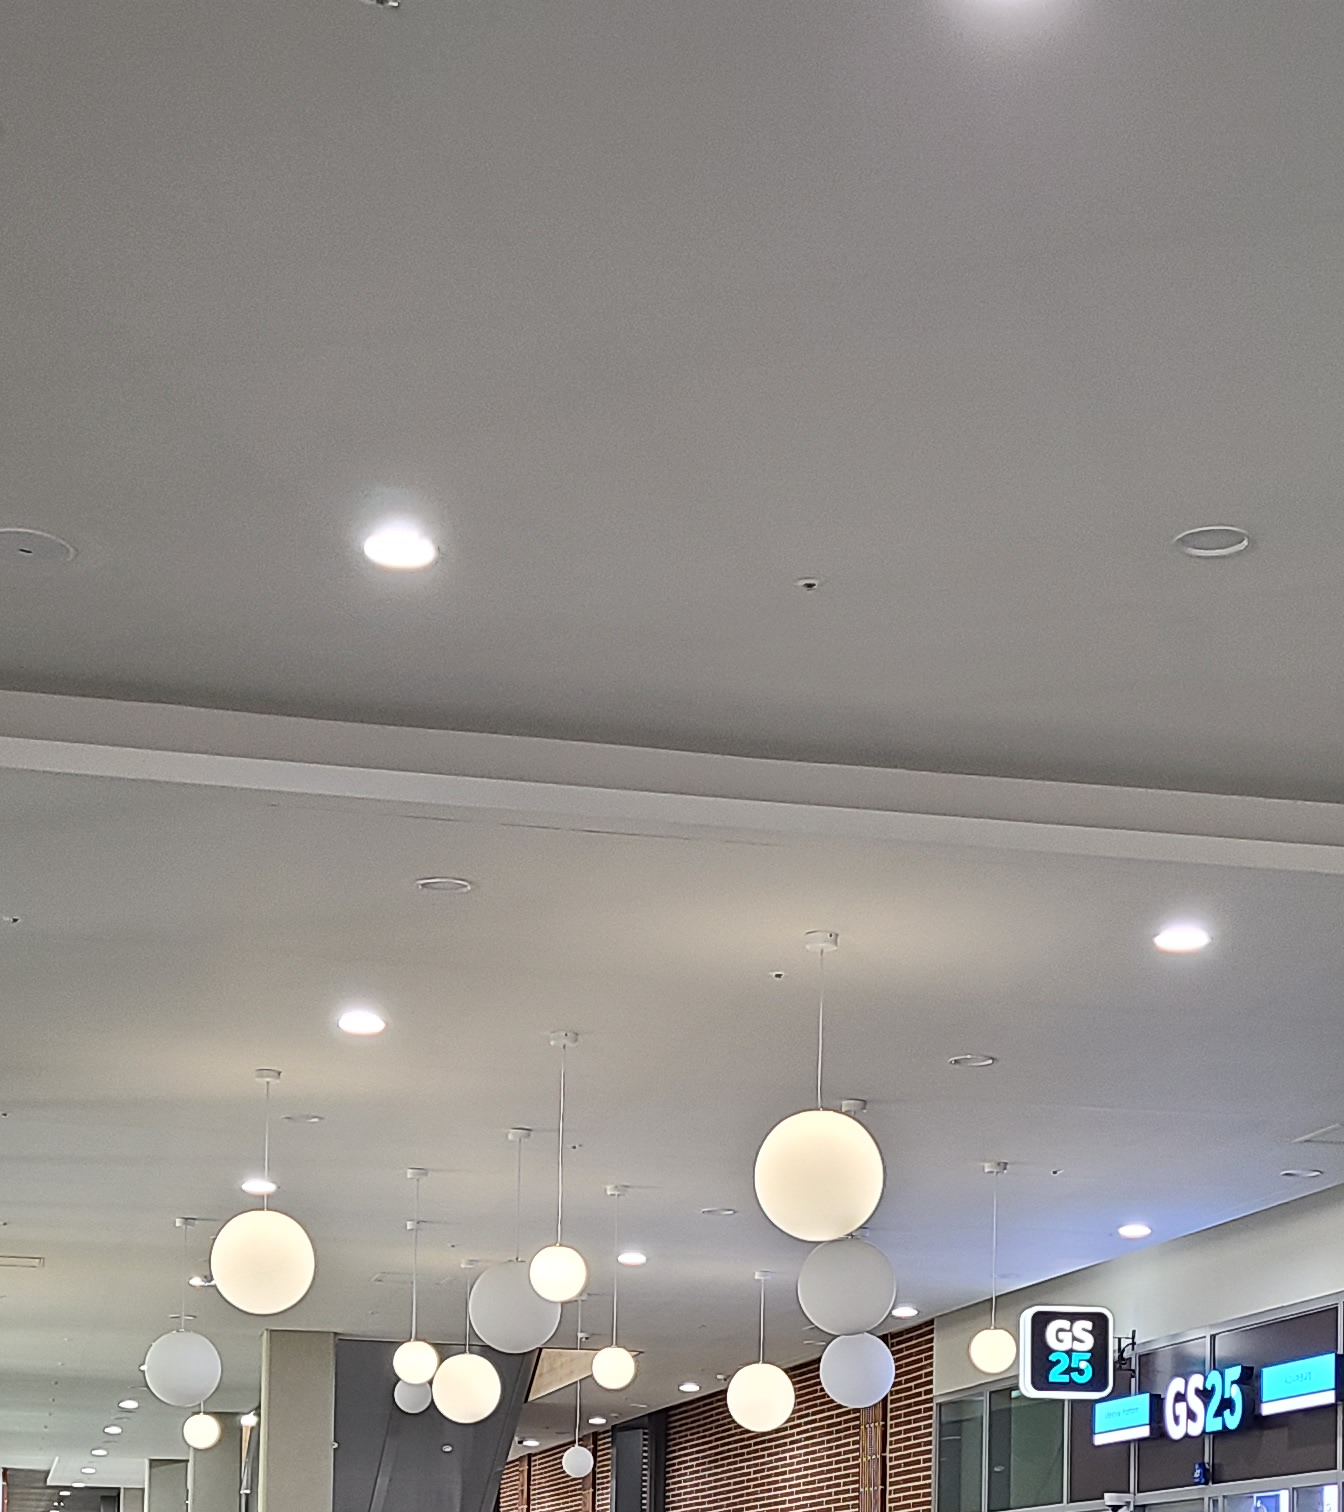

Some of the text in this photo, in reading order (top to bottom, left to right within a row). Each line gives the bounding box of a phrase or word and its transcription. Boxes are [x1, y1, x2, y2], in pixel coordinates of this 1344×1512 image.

[1045, 1319, 1094, 1351] GS
[1047, 1351, 1093, 1384] 25
[1164, 1364, 1244, 1441] GS25
